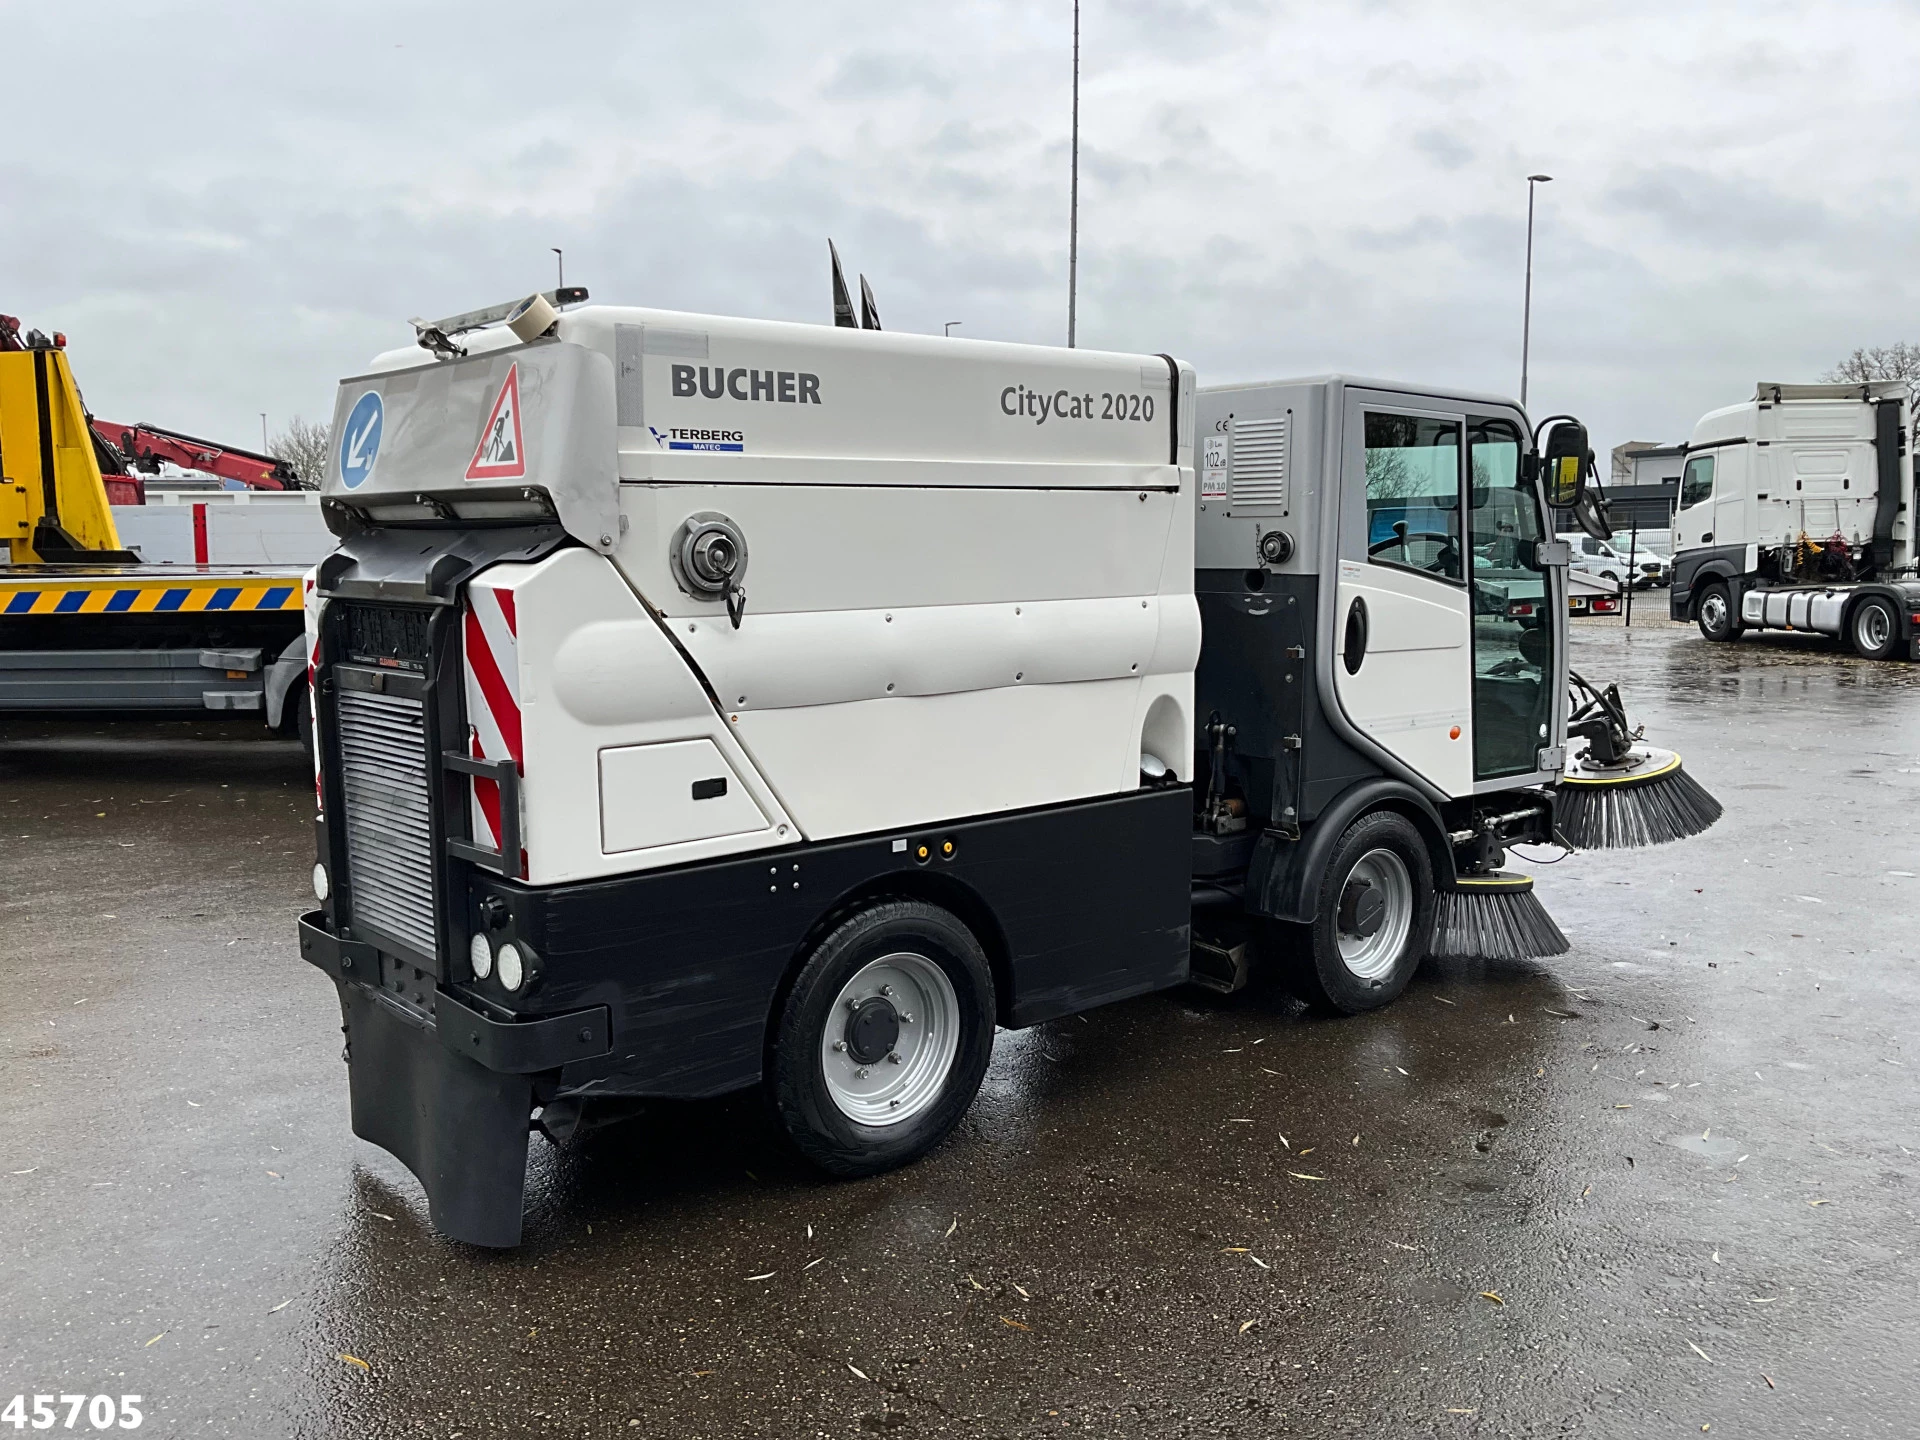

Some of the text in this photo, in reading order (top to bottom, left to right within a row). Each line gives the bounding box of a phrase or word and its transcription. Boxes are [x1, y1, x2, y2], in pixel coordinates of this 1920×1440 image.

[671, 364, 822, 405] BUCHER
[1000, 384, 1155, 426] CityCat 2020
[669, 428, 744, 442] TERBERG
[692, 443, 721, 451] MATEC
[1205, 452, 1219, 467] 102
[1203, 482, 1226, 490] PM 10
